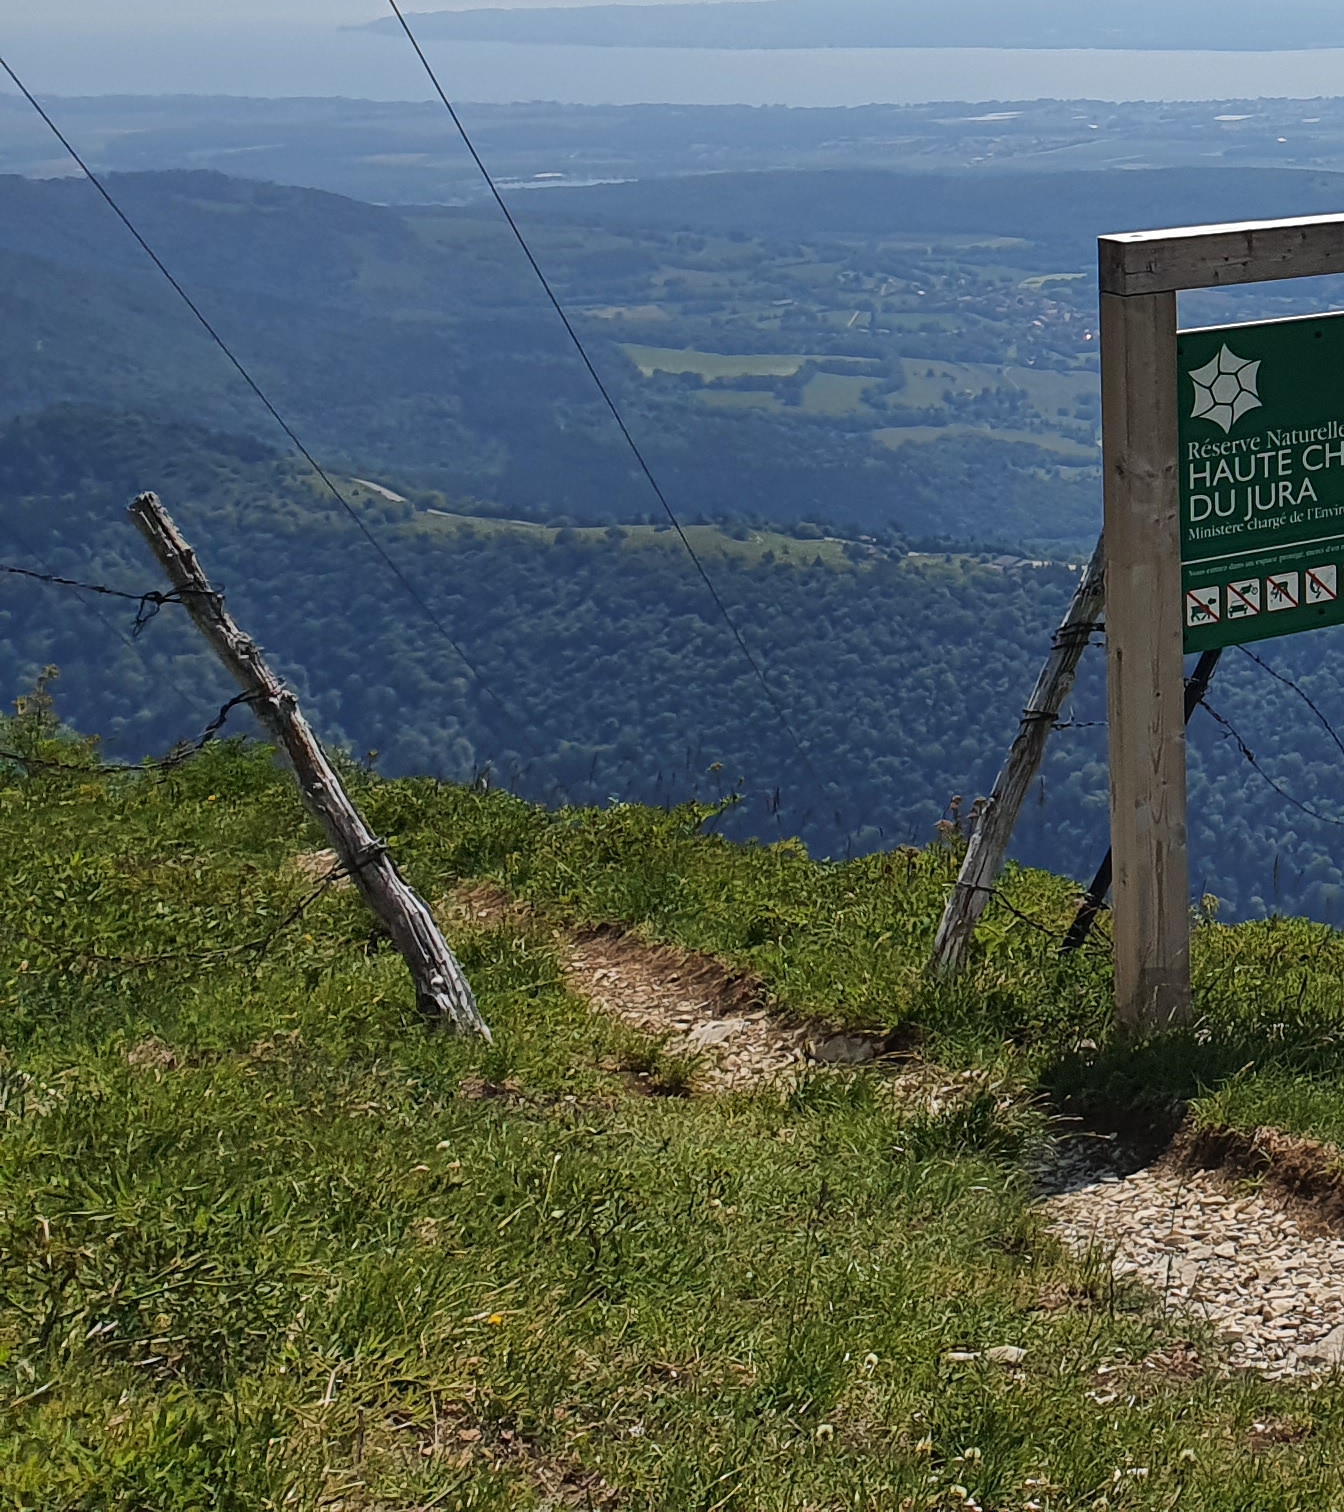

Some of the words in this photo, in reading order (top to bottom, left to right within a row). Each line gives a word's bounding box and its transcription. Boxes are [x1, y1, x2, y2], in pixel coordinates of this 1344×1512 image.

[1188, 438, 1261, 460] Réserve
[1189, 449, 1293, 490] HAUTE
[1190, 489, 1236, 522] DU
[1243, 477, 1318, 522] JURA
[1188, 521, 1245, 541] Ministère
[1247, 511, 1287, 530] chargé
[1289, 510, 1305, 524] de
